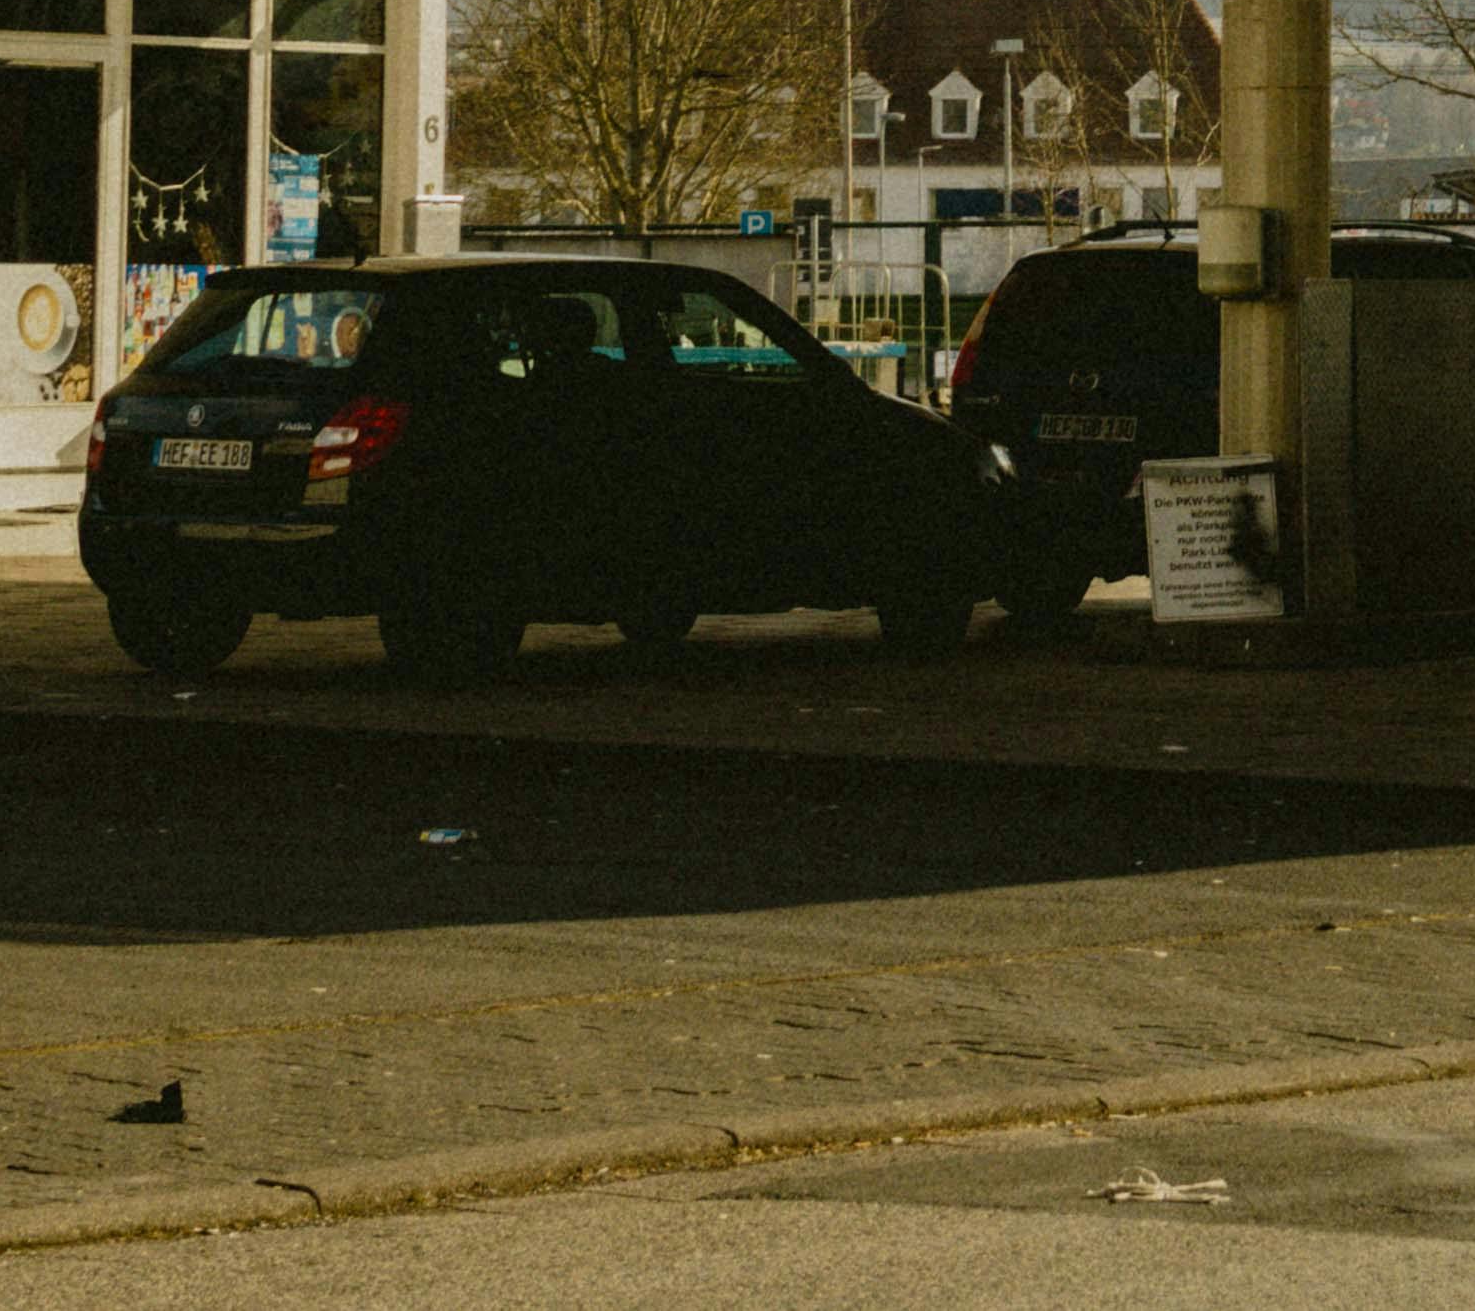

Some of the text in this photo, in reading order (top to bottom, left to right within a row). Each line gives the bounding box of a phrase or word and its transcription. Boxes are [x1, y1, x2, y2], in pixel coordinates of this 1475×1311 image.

[424, 114, 439, 144] 6
[747, 215, 766, 235] P
[162, 441, 191, 465] HEF
[199, 443, 215, 465] EE
